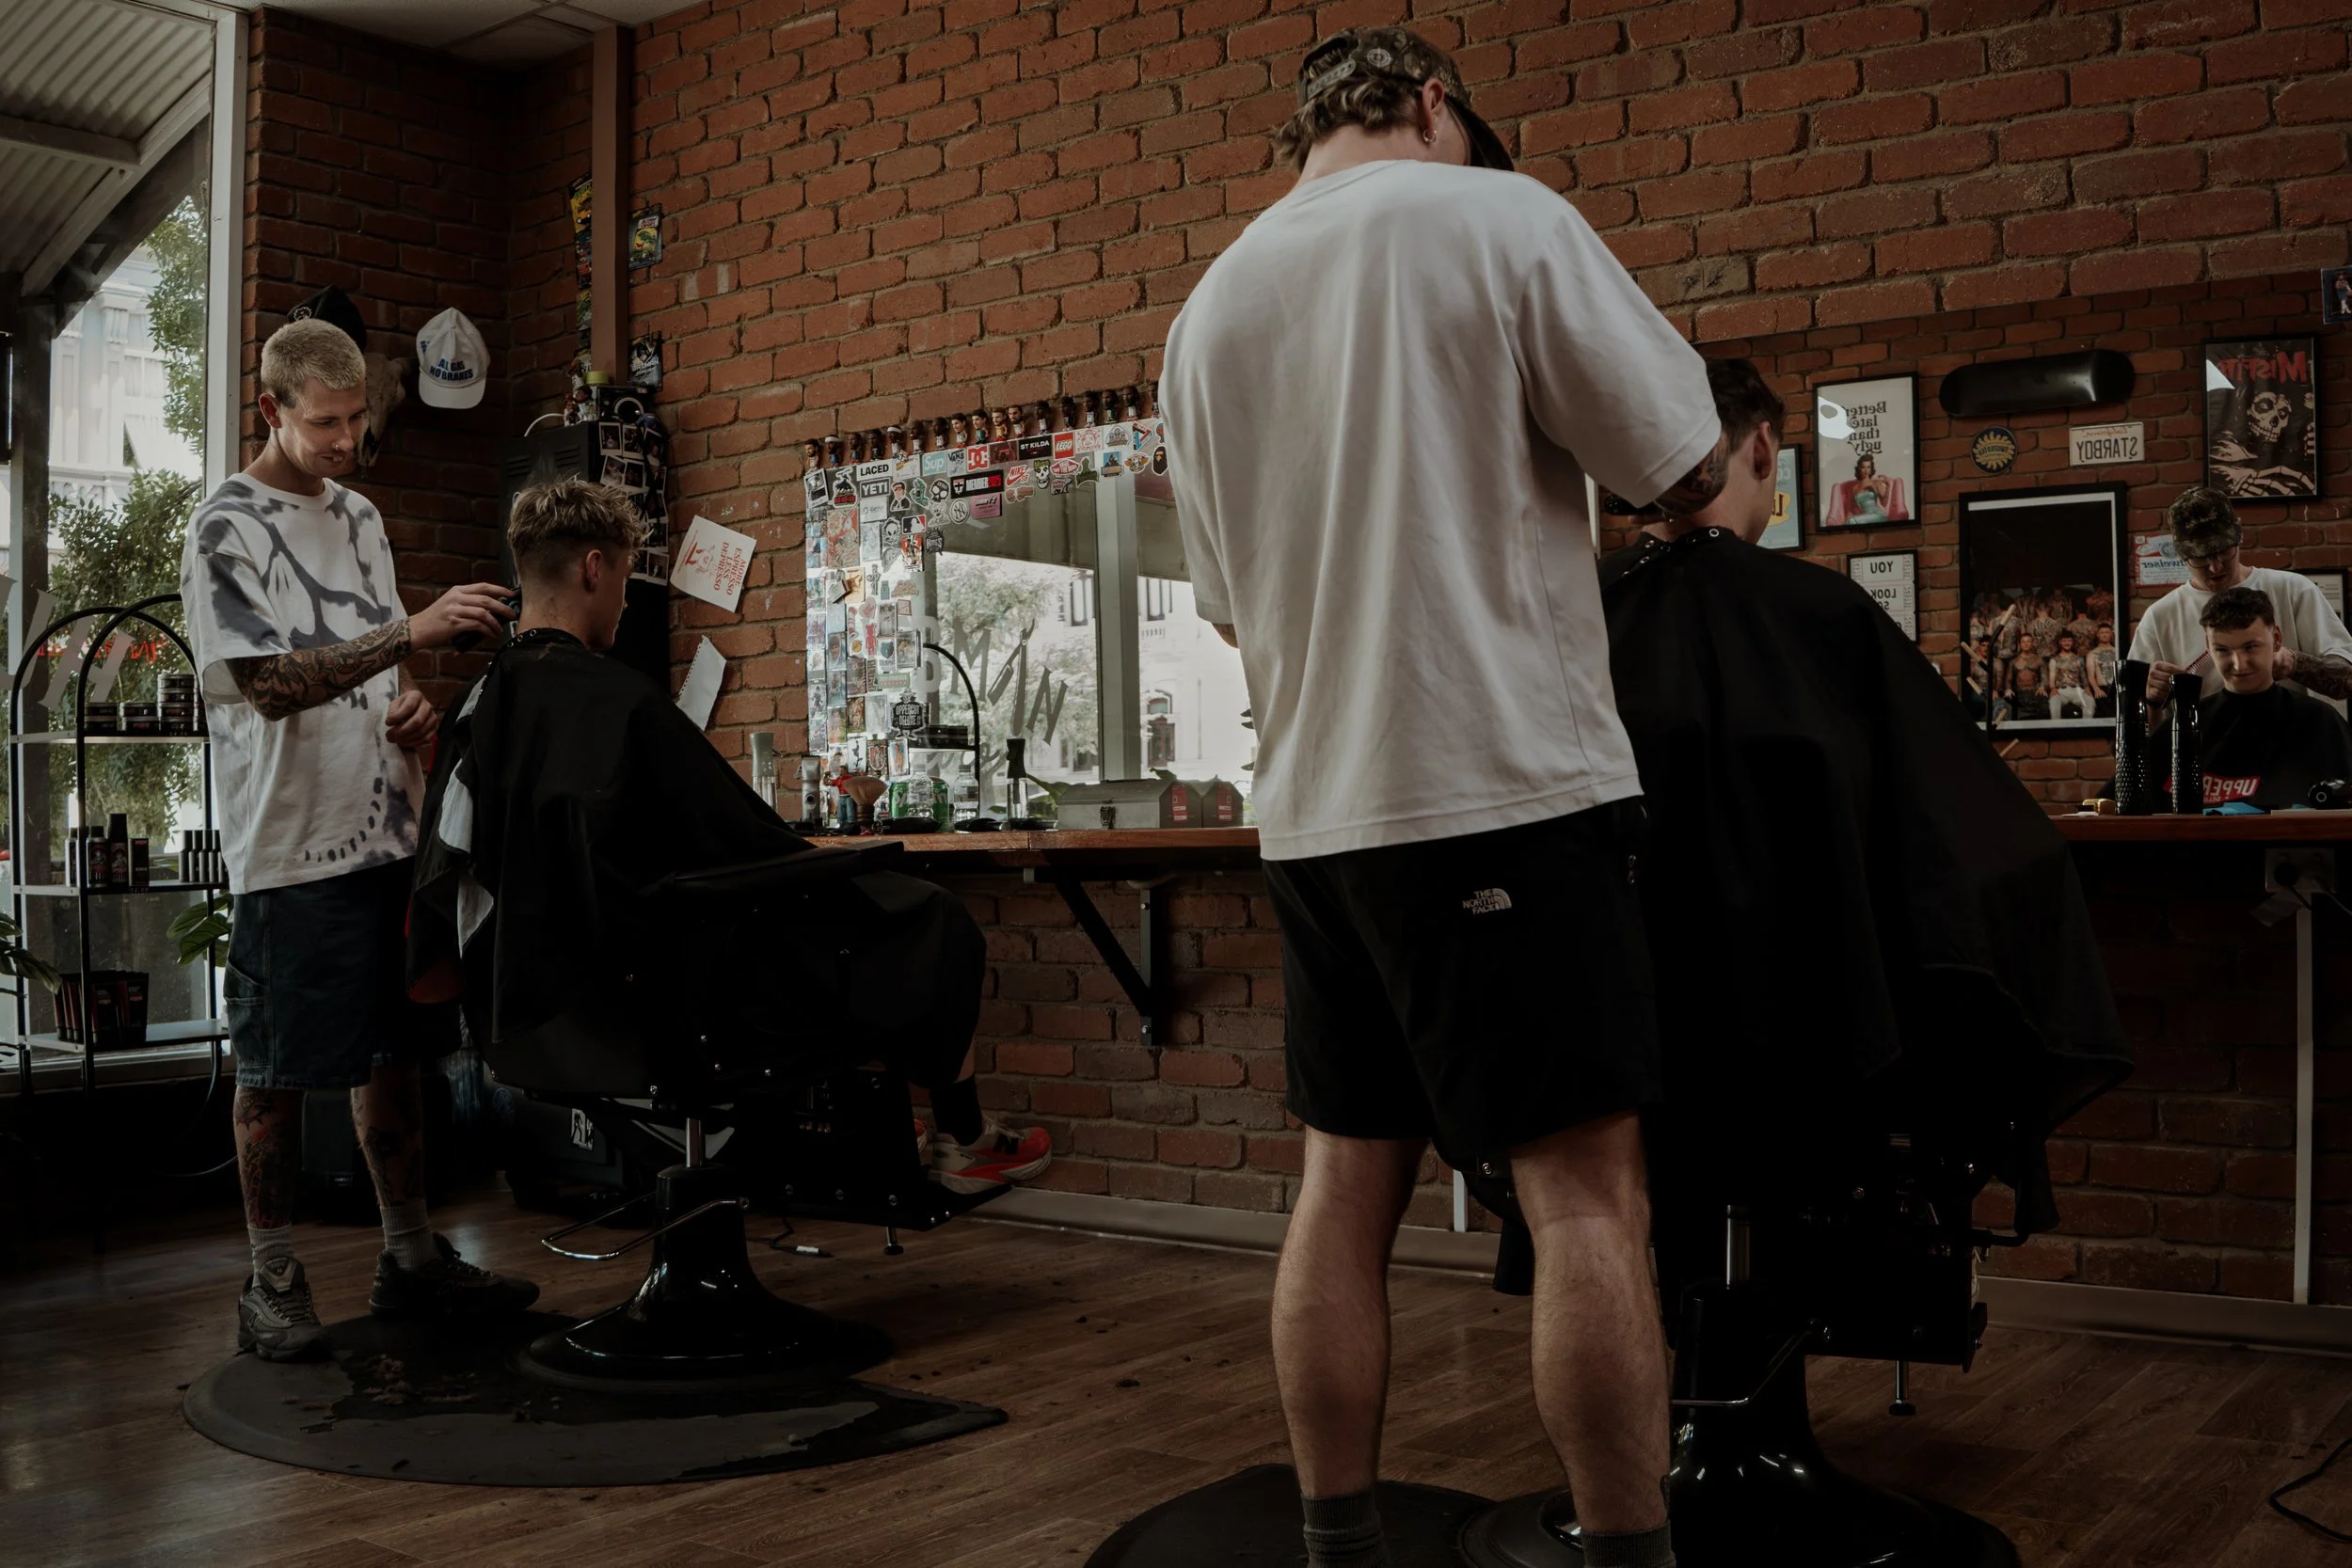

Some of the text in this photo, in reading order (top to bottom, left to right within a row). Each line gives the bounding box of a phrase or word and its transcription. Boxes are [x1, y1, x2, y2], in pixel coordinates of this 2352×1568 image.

[429, 366, 474, 382] NO BRAKES
[1020, 442, 1030, 451] ST
[1030, 438, 1051, 450] KILDA
[1056, 439, 1072, 451] LEGO
[947, 449, 964, 462] VANS
[860, 464, 889, 477] LACED
[924, 455, 945, 472] Sup
[1009, 465, 1025, 477] NIKE
[861, 481, 888, 497] YETI
[713, 541, 730, 591] DEPRESSO
[723, 556, 734, 579] LESS
[726, 546, 742, 595] ESPRESSO
[1473, 888, 1493, 899] THE
[1462, 895, 1495, 911] NORTH
[1471, 903, 1496, 915] FACE
